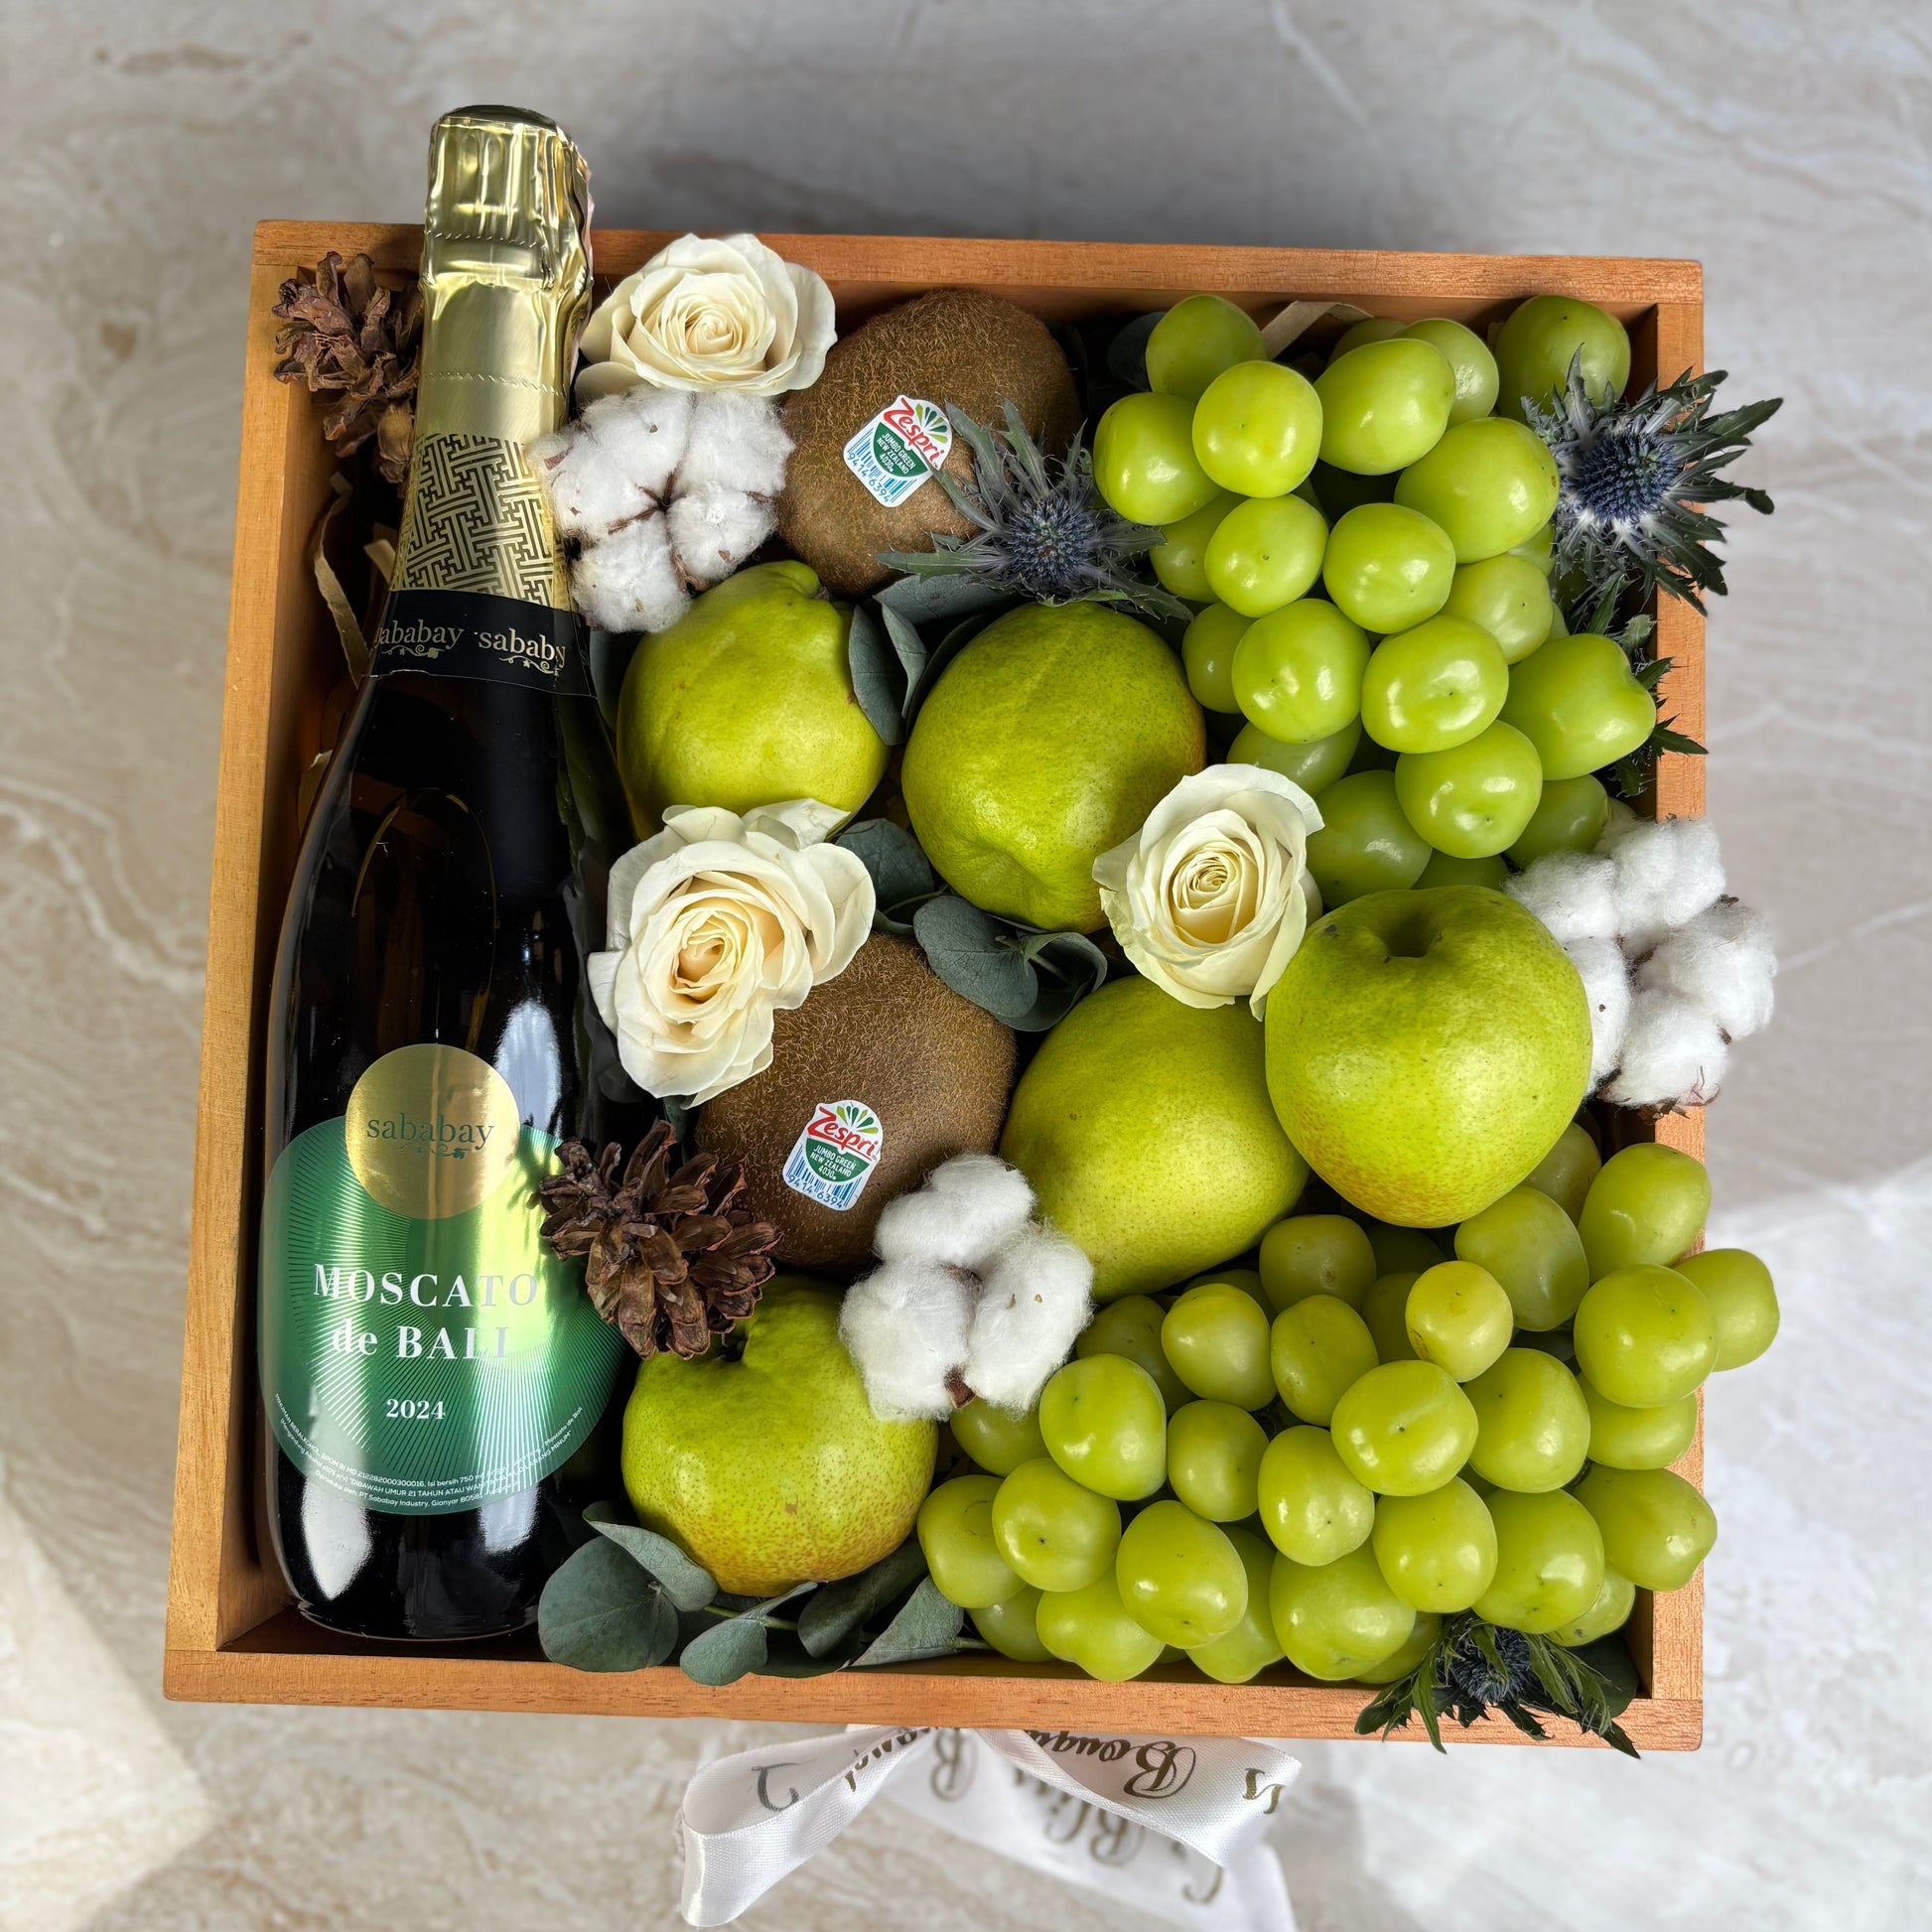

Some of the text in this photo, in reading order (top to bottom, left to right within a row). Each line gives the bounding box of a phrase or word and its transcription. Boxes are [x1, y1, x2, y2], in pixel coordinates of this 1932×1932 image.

[884, 397, 945, 465] Zespri
[877, 438, 909, 475] NEW ZEALAND
[879, 453, 893, 471] 4030
[882, 433, 916, 470] JUMBO GREEN
[379, 620, 465, 650] ababay
[366, 1112, 495, 1151] sababay
[807, 1106, 879, 1161] Zespri
[810, 1152, 852, 1177] NEW ZEALAND
[813, 1145, 856, 1171] JUMBO GREEN
[818, 1166, 835, 1178] 4030
[314, 1264, 538, 1307] MOSCATO
[332, 1319, 510, 1360] de BALI
[386, 1399, 446, 1420] 2024
[437, 1478, 459, 1487] bersih
[460, 1474, 475, 1484] 750
[544, 1425, 568, 1446] Moscato
[368, 1494, 398, 1506] Sababay
[431, 1498, 459, 1507] Gianyar
[384, 1487, 407, 1497] UMUR
[445, 1486, 465, 1495] ATAU
